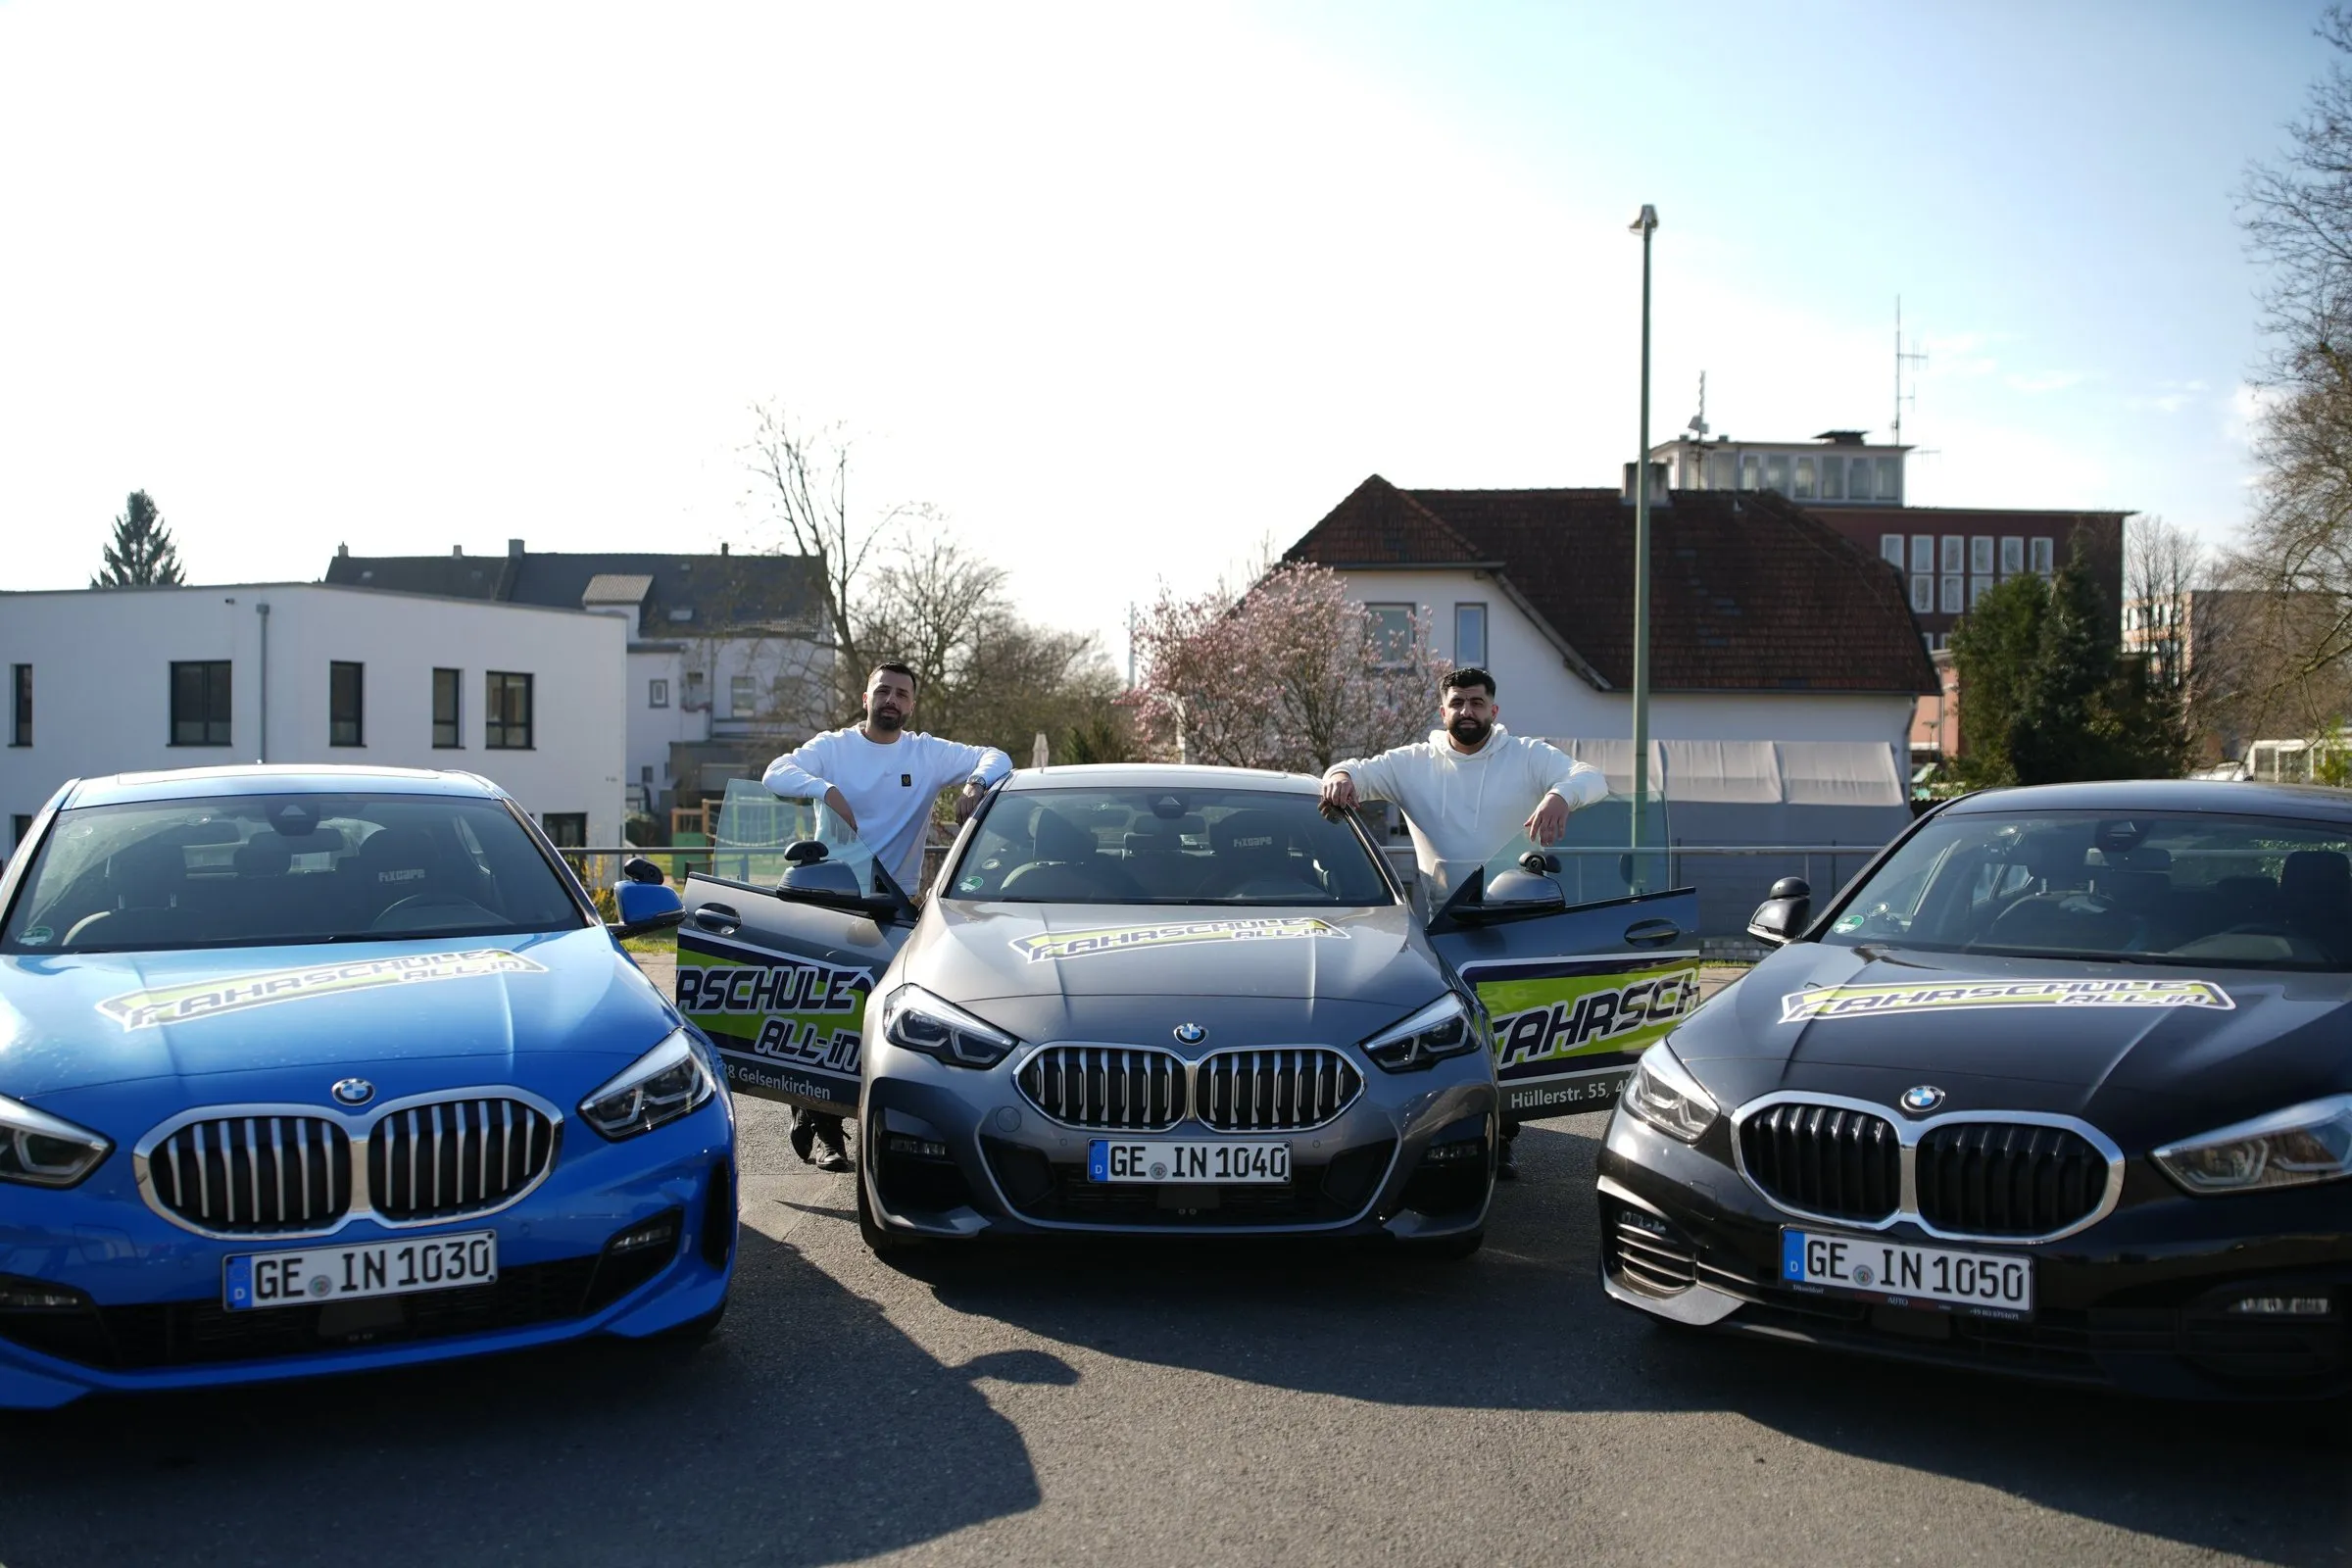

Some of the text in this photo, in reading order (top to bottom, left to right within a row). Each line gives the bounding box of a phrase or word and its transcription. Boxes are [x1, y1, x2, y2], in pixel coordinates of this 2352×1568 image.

[1030, 919, 1308, 961] FAHRSCHULE
[128, 951, 488, 1027] FAHRSCHULE
[1786, 981, 2191, 1020] FAHRSCHULE
[738, 1067, 831, 1100] Gelsenkirchen
[1510, 1087, 1583, 1108] Hüllerstr.
[1588, 1082, 1610, 1099] 55,
[1095, 1146, 1286, 1178] D GE IN 1040
[234, 1239, 490, 1300] D GE IN 1030
[1790, 1240, 2023, 1301] D GE IN 1050
